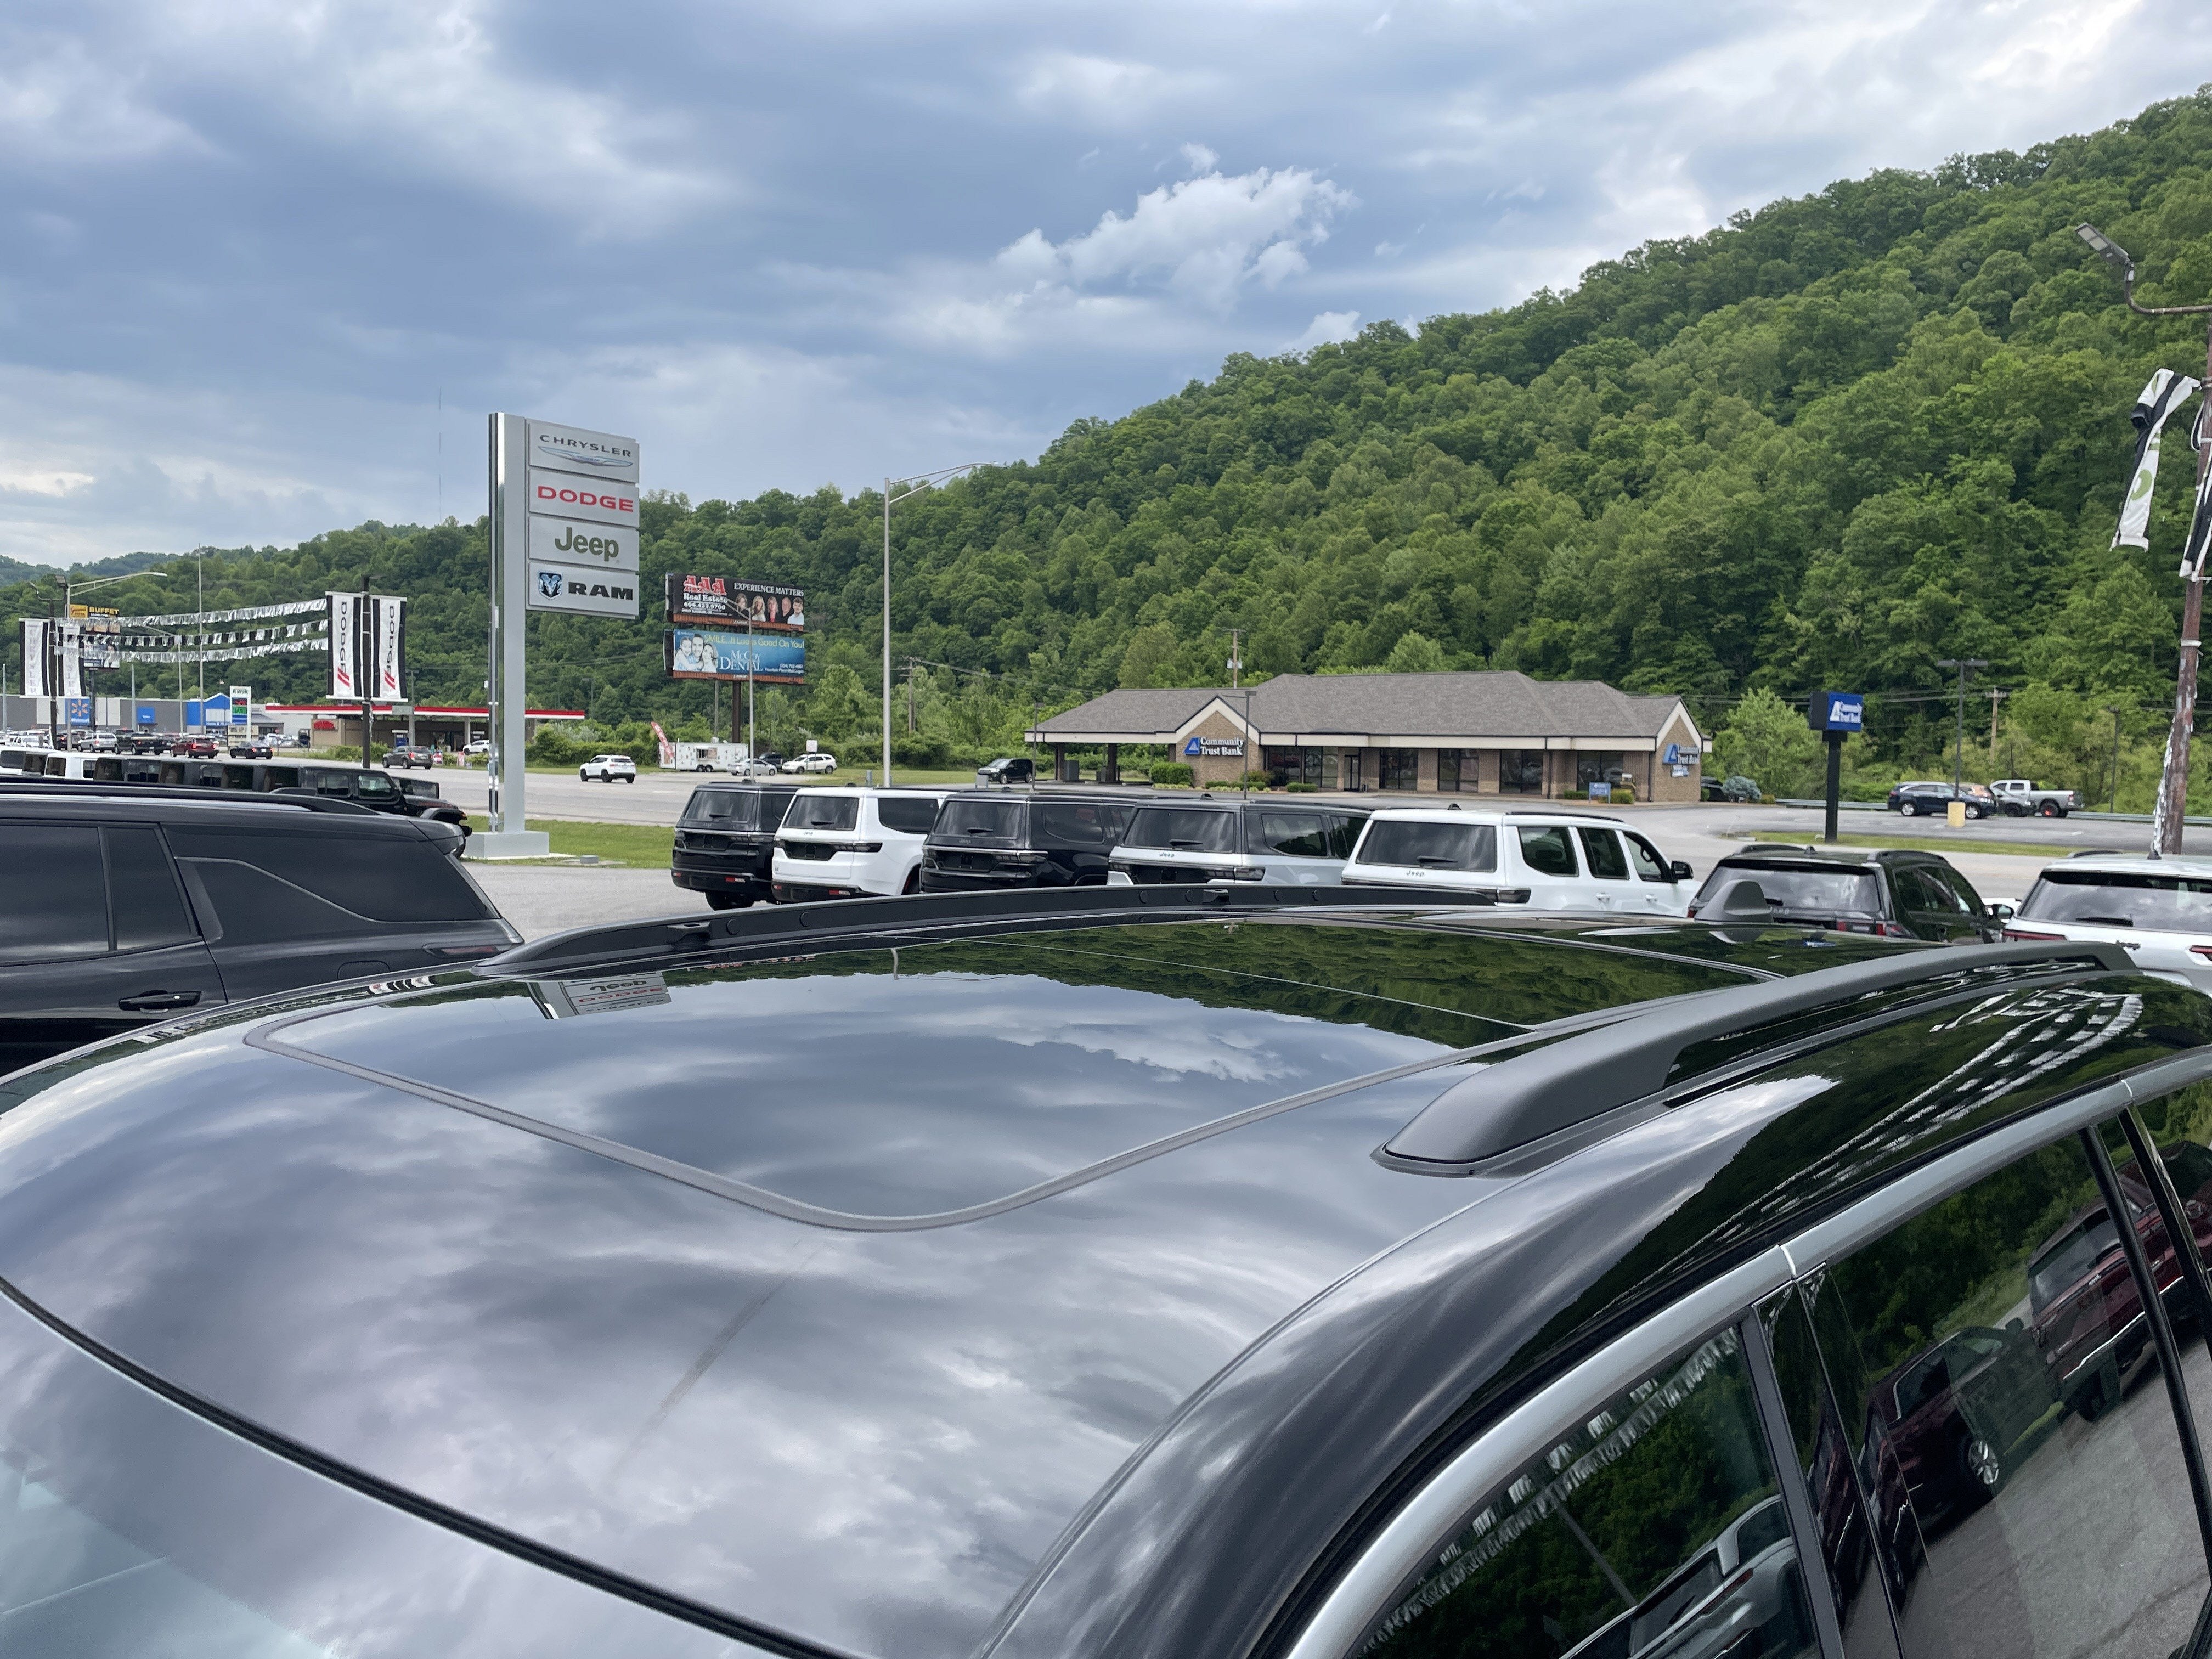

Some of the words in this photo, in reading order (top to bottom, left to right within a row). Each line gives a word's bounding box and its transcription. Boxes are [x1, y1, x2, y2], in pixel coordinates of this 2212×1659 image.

[539, 435, 631, 458] CHRYSLER
[537, 486, 634, 512] DODGE
[555, 526, 619, 562] Jeep
[568, 582, 633, 600] RAM
[683, 575, 727, 596] AAA
[733, 582, 775, 594] EXPERIENCE
[775, 586, 805, 597] MATTERS
[683, 592, 701, 601] Real
[89, 606, 119, 615] BUFFET
[758, 637, 778, 647] Good
[778, 639, 789, 648] On
[790, 640, 805, 649] You!
[1200, 736, 1244, 748] Community
[1200, 746, 1220, 755] Trust
[1221, 746, 1243, 755] Bank
